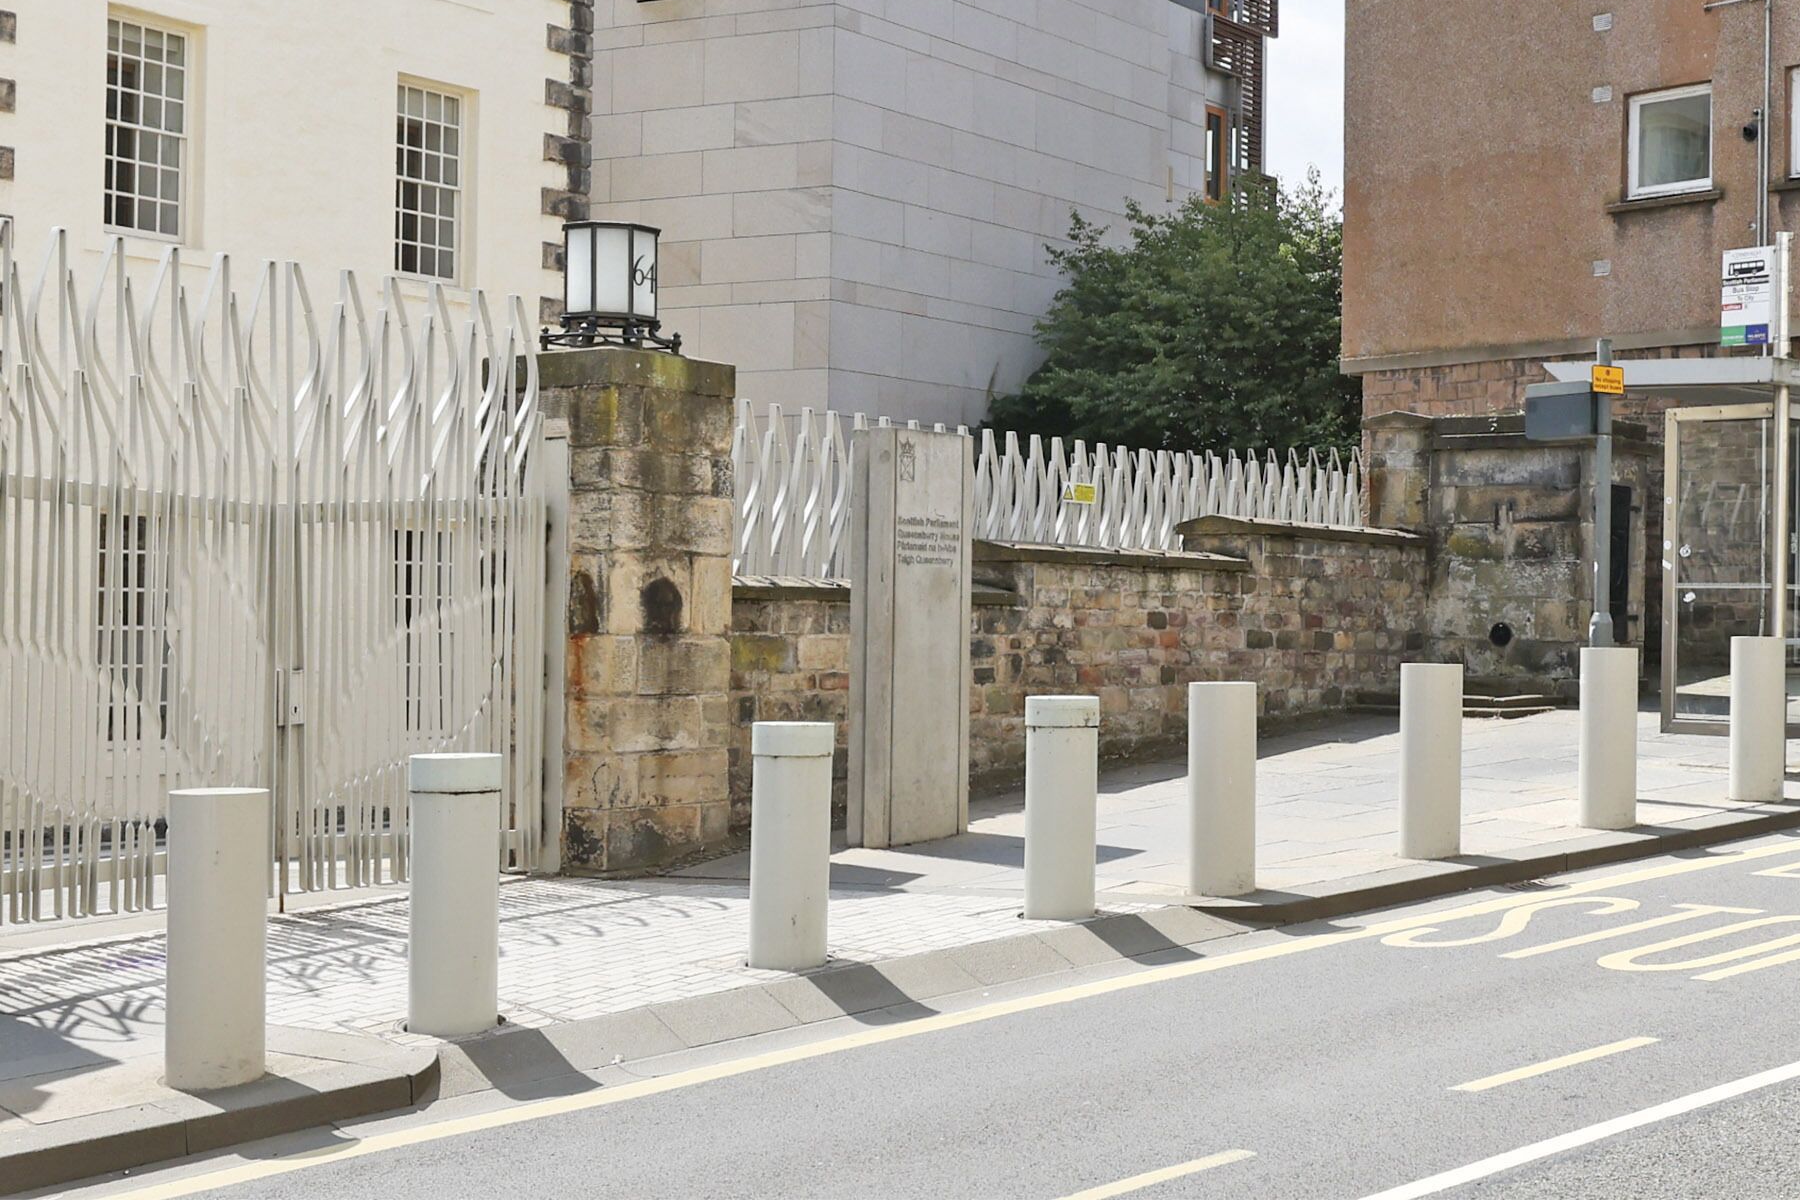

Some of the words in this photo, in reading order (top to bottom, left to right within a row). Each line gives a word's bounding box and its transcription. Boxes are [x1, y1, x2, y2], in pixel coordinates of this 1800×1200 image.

[633, 255, 657, 294] 64
[898, 516, 924, 526] Scottish
[926, 518, 959, 528] Parliament
